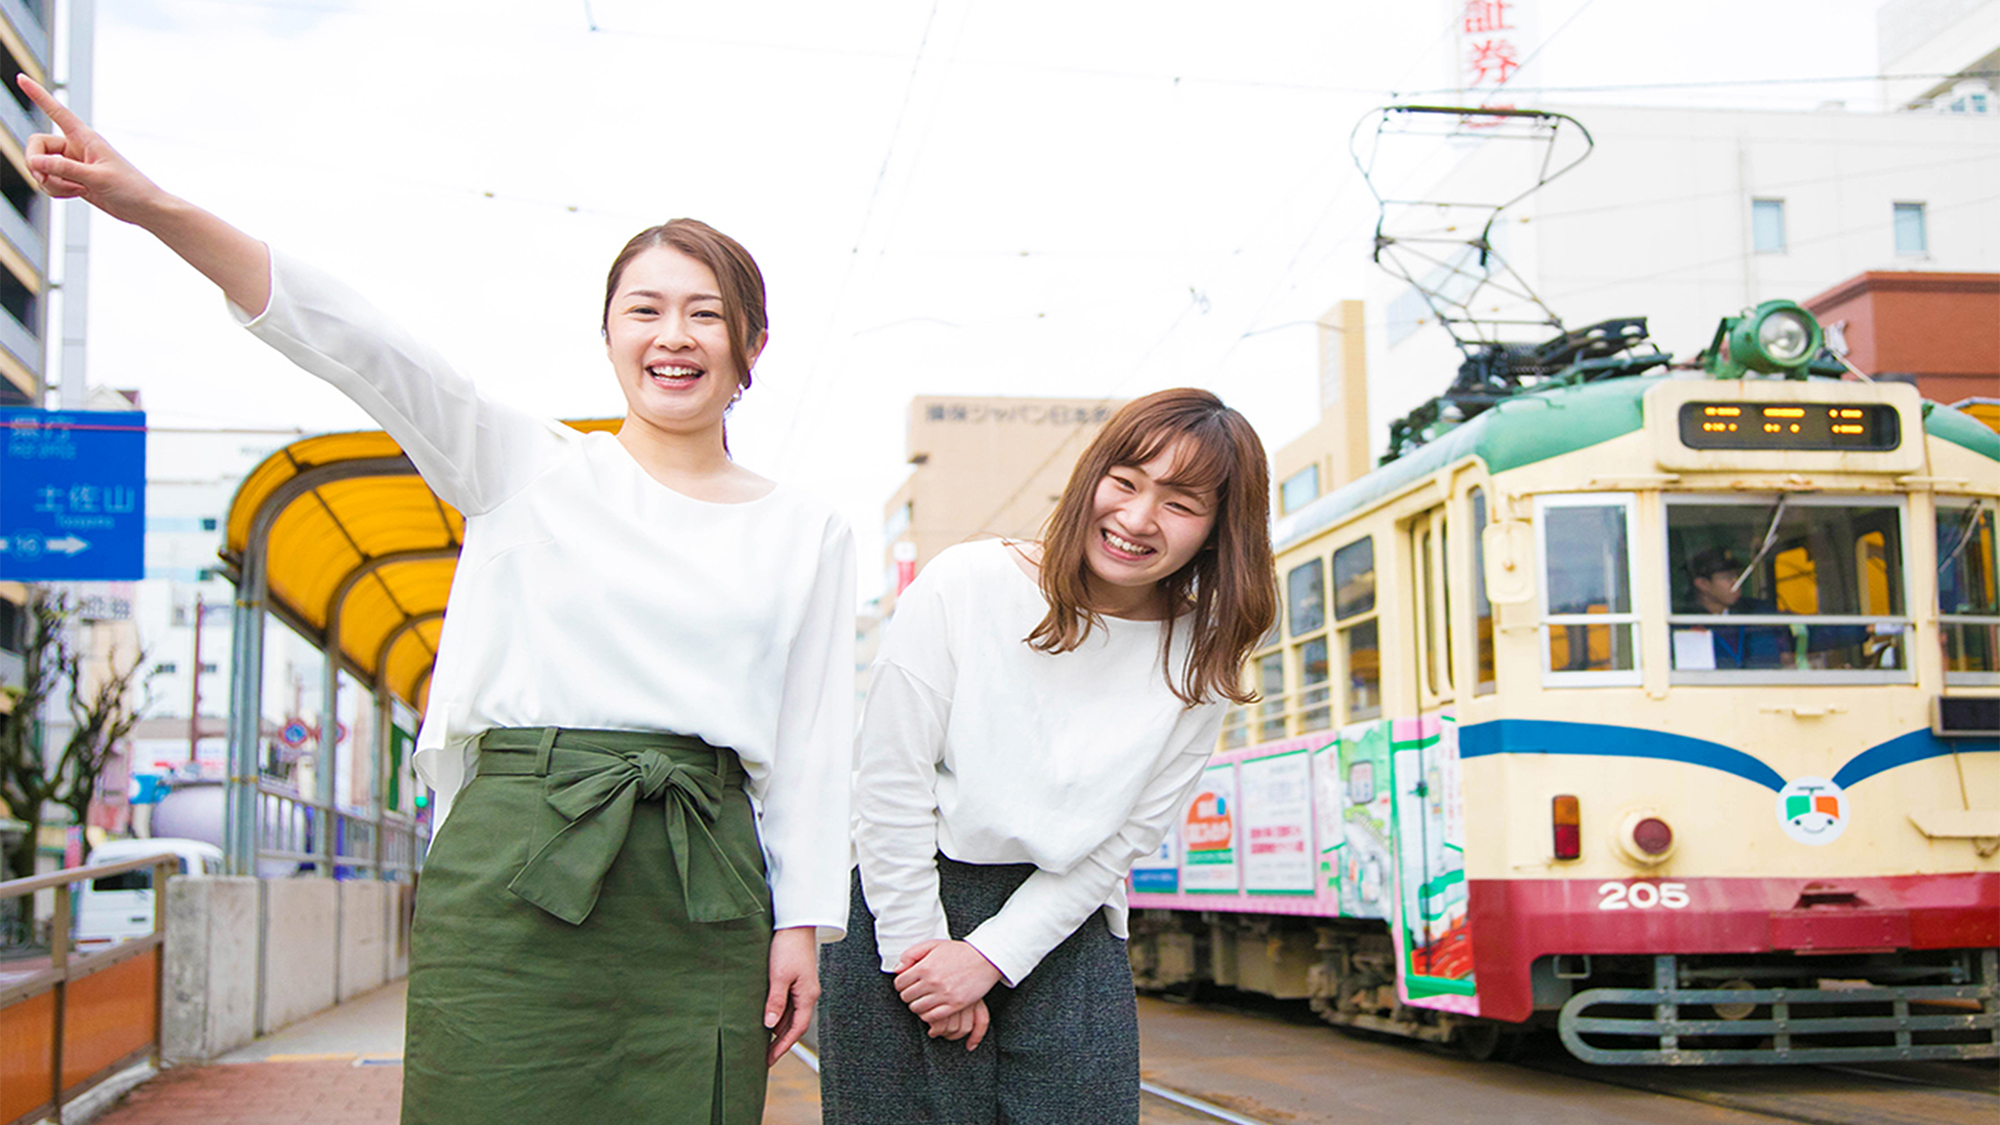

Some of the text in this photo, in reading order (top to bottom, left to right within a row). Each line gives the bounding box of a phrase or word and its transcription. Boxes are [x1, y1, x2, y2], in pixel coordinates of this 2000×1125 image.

[36, 484, 135, 513] 土佐山
[1598, 882, 1690, 910] 205
